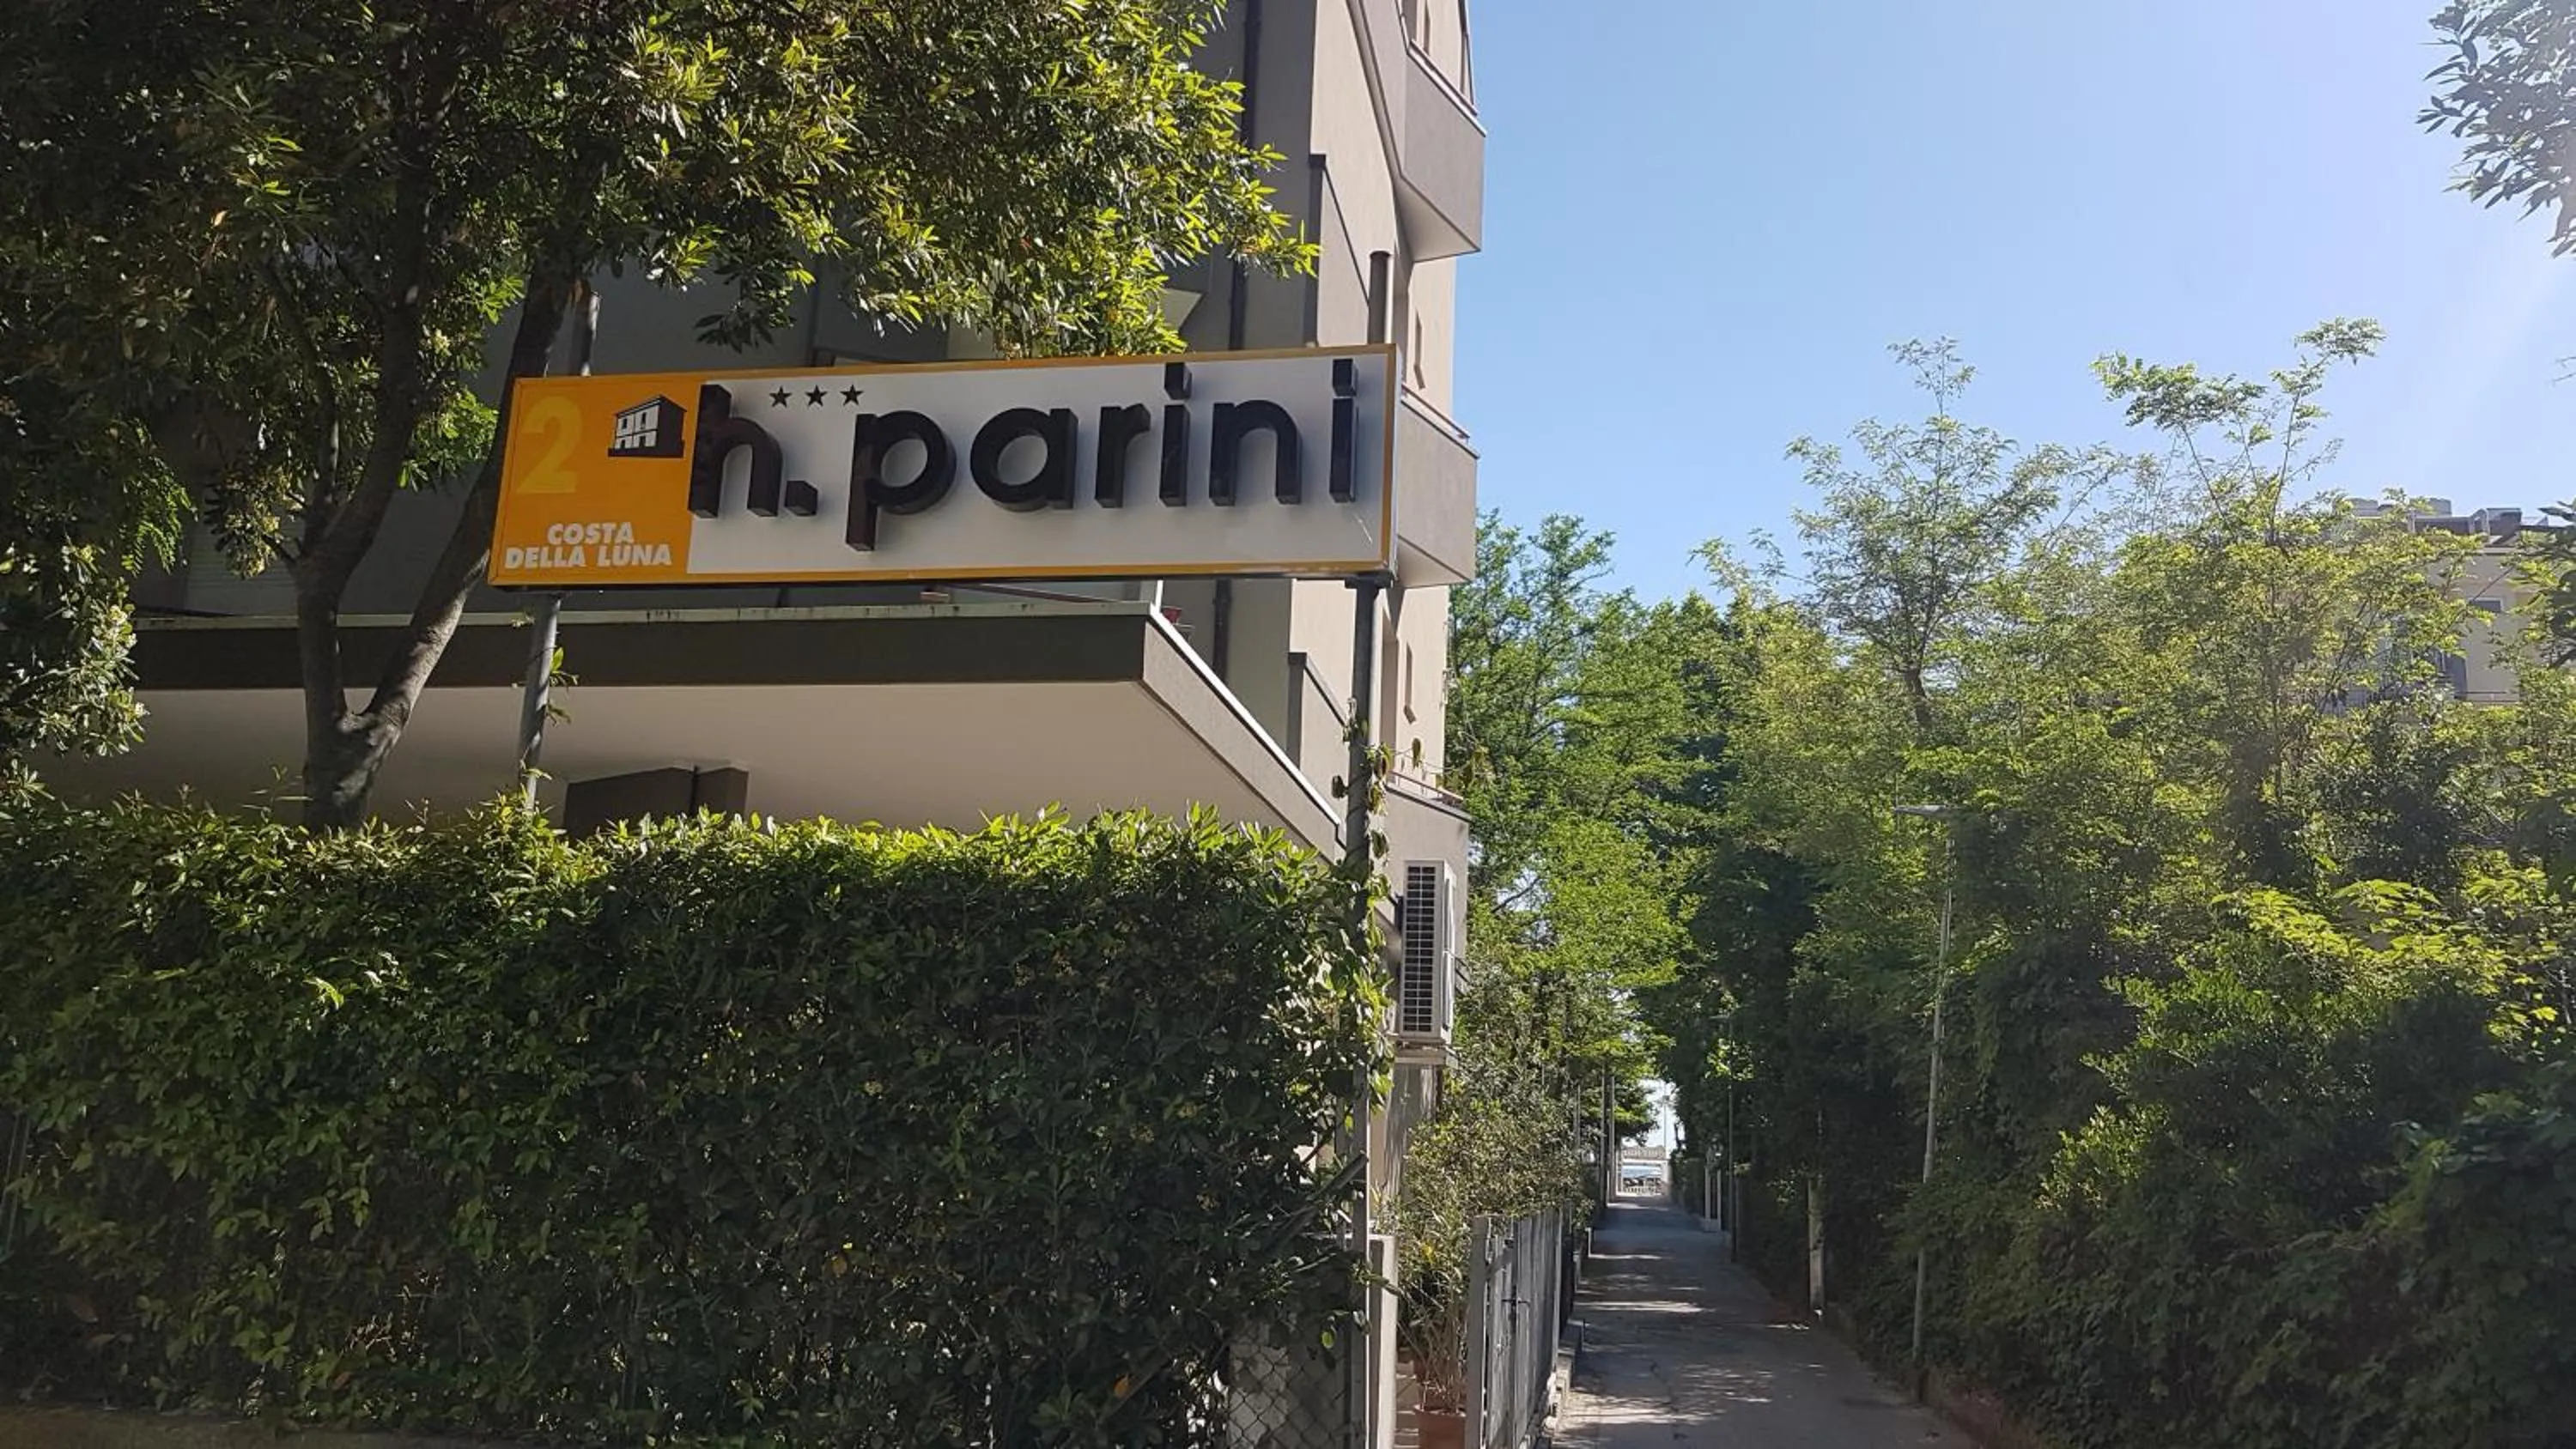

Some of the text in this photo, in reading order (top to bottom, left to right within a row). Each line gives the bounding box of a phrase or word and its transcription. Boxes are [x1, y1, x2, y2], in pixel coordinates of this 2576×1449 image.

[517, 395, 584, 494] 2
[687, 357, 1360, 552] h. parini
[504, 543, 672, 569] DELLA LUNA
[547, 521, 635, 545] COSTA
